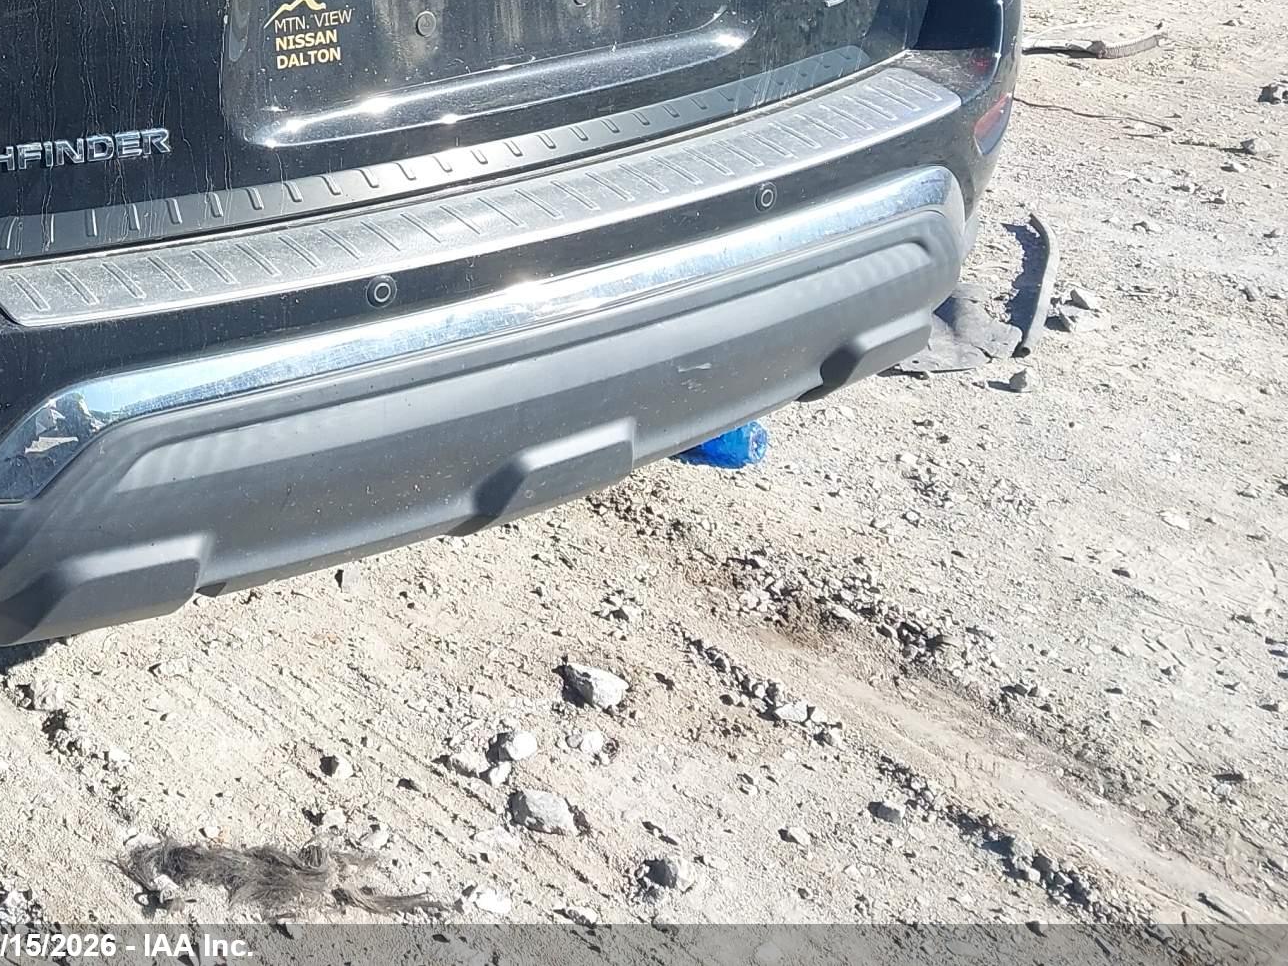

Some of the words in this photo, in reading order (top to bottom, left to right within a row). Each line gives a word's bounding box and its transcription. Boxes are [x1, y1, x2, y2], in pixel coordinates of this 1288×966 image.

[274, 16, 310, 33] MTN.
[314, 9, 352, 27] VIEW
[275, 30, 337, 51] NISSAN
[276, 47, 341, 69] DALTON
